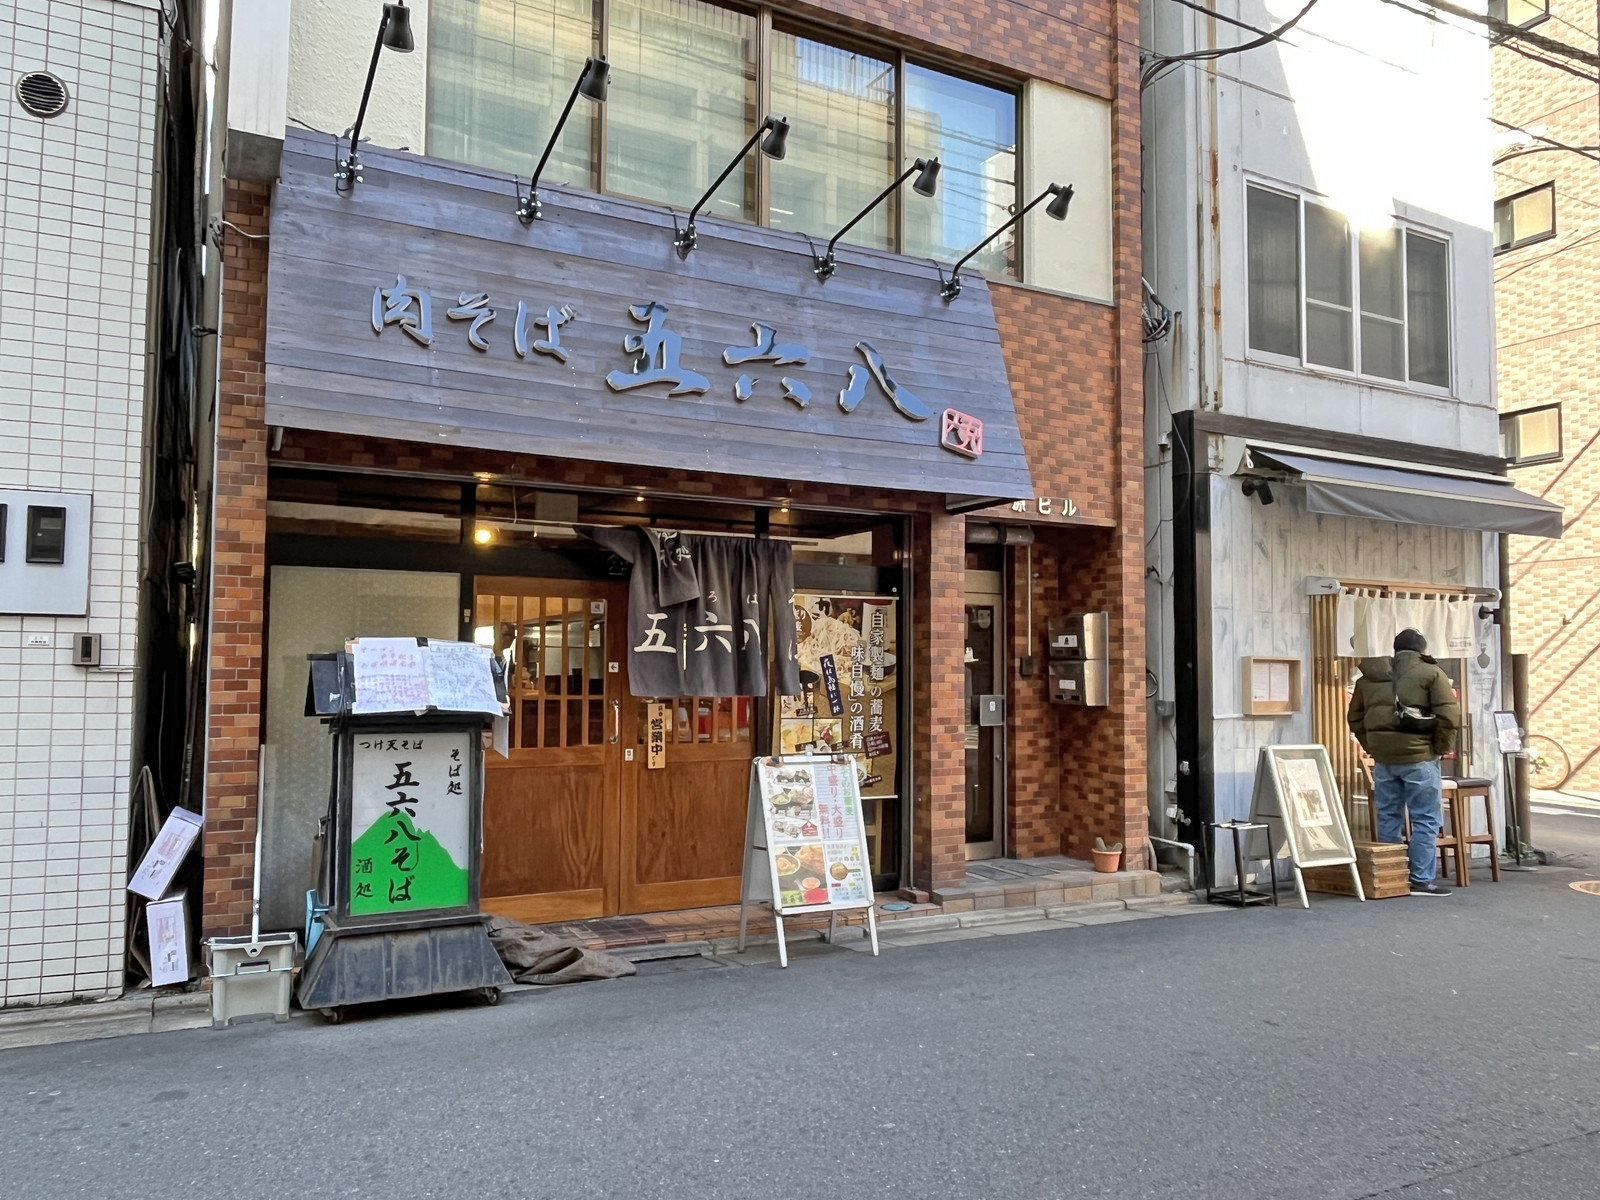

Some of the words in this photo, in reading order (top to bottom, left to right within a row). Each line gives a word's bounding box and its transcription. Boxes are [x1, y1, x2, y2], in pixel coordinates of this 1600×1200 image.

[371, 273, 577, 362] 肉そば
[605, 301, 932, 421] 五六八
[359, 739, 424, 752] つけ天そば
[650, 718, 664, 756] 営業中
[446, 748, 463, 796] そば処
[384, 761, 423, 905] 五六八そば
[355, 857, 374, 899] 酒処
